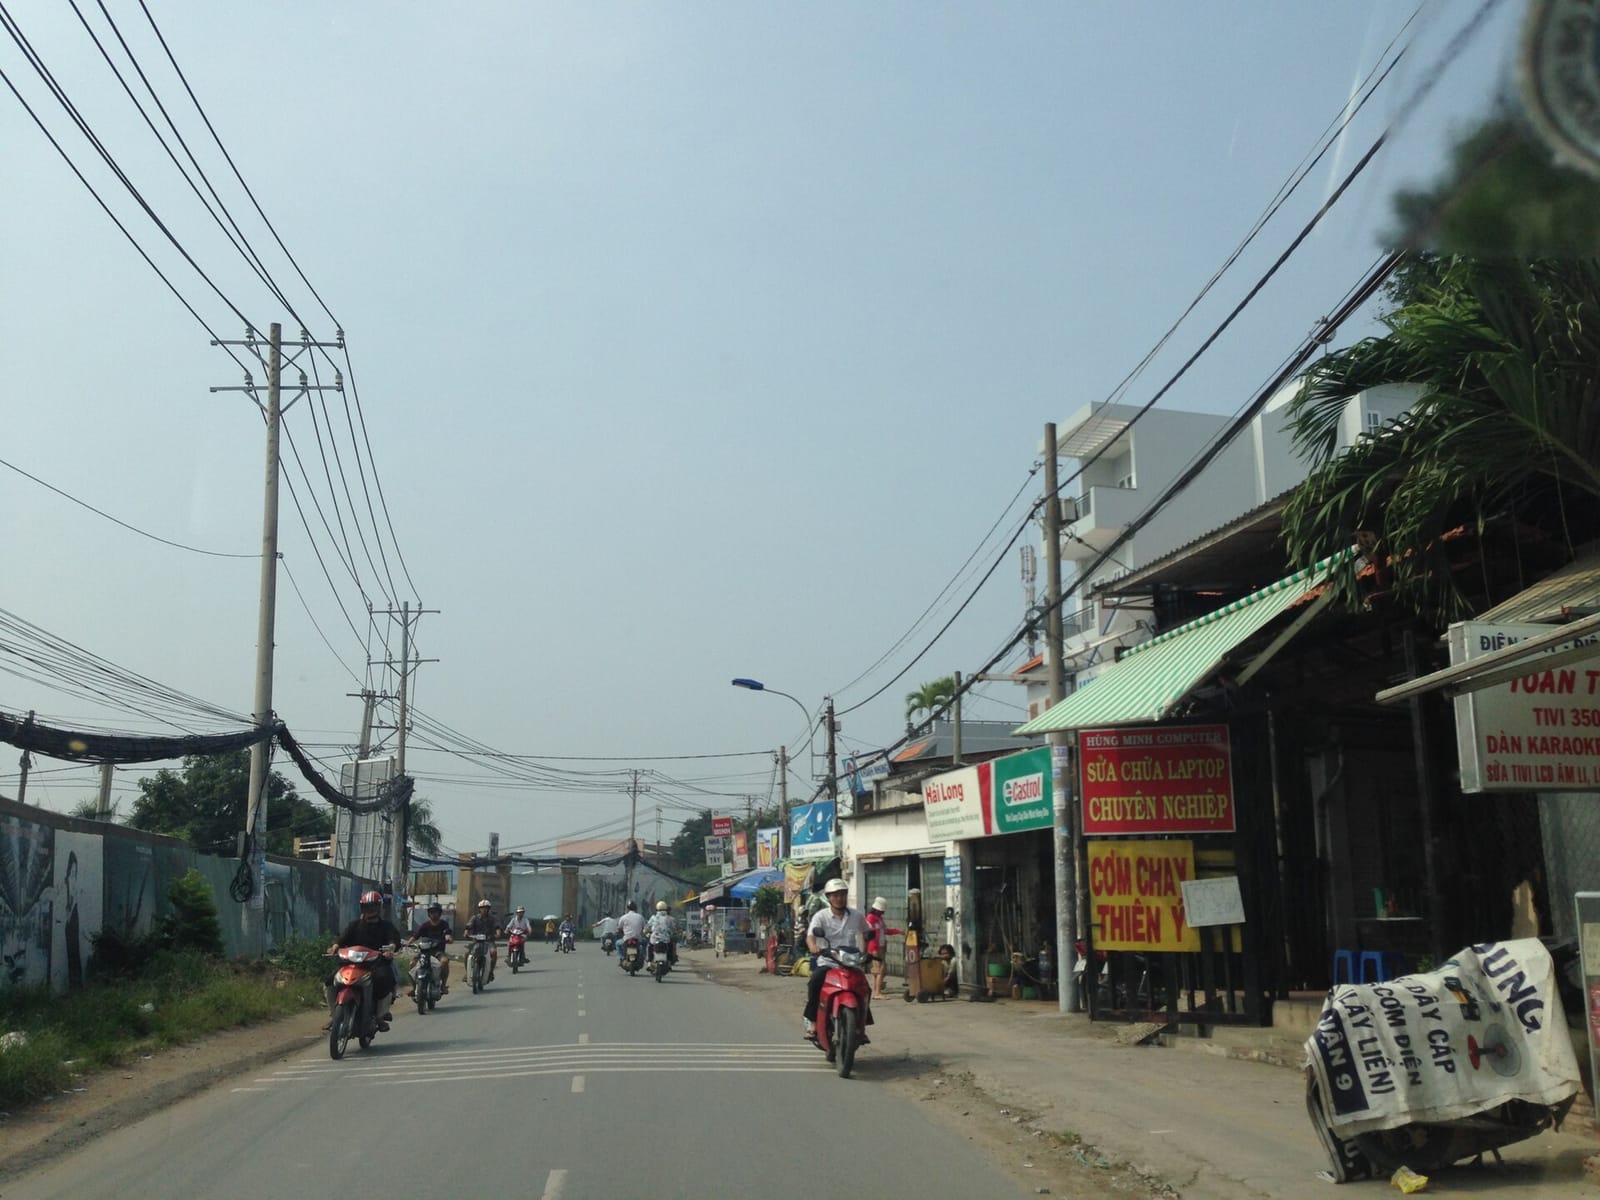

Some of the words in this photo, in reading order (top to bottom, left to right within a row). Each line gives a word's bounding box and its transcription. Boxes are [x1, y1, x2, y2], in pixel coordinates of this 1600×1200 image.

[1532, 707, 1566, 726] TIVI
[1123, 734, 1153, 746] MINH
[1157, 731, 1222, 745] COMPUTER
[1486, 729, 1523, 754] DÀN
[1087, 754, 1118, 783] SỬA
[1121, 755, 1165, 781] CHỮA
[1167, 757, 1225, 780] LAPTOP
[1512, 764, 1532, 782] TIVI
[1535, 765, 1554, 783] LCD
[941, 782, 964, 803] Long
[1013, 776, 1041, 802] Castrol
[1089, 789, 1157, 822] CHUYÊN
[1162, 787, 1228, 825] NGHIỆP
[1091, 849, 1132, 897] CƠM
[1136, 855, 1188, 897] CHAY
[1097, 898, 1161, 943] THIÊN
[1318, 1014, 1347, 1067] UẬN
[1336, 1073, 1354, 1091] 9
